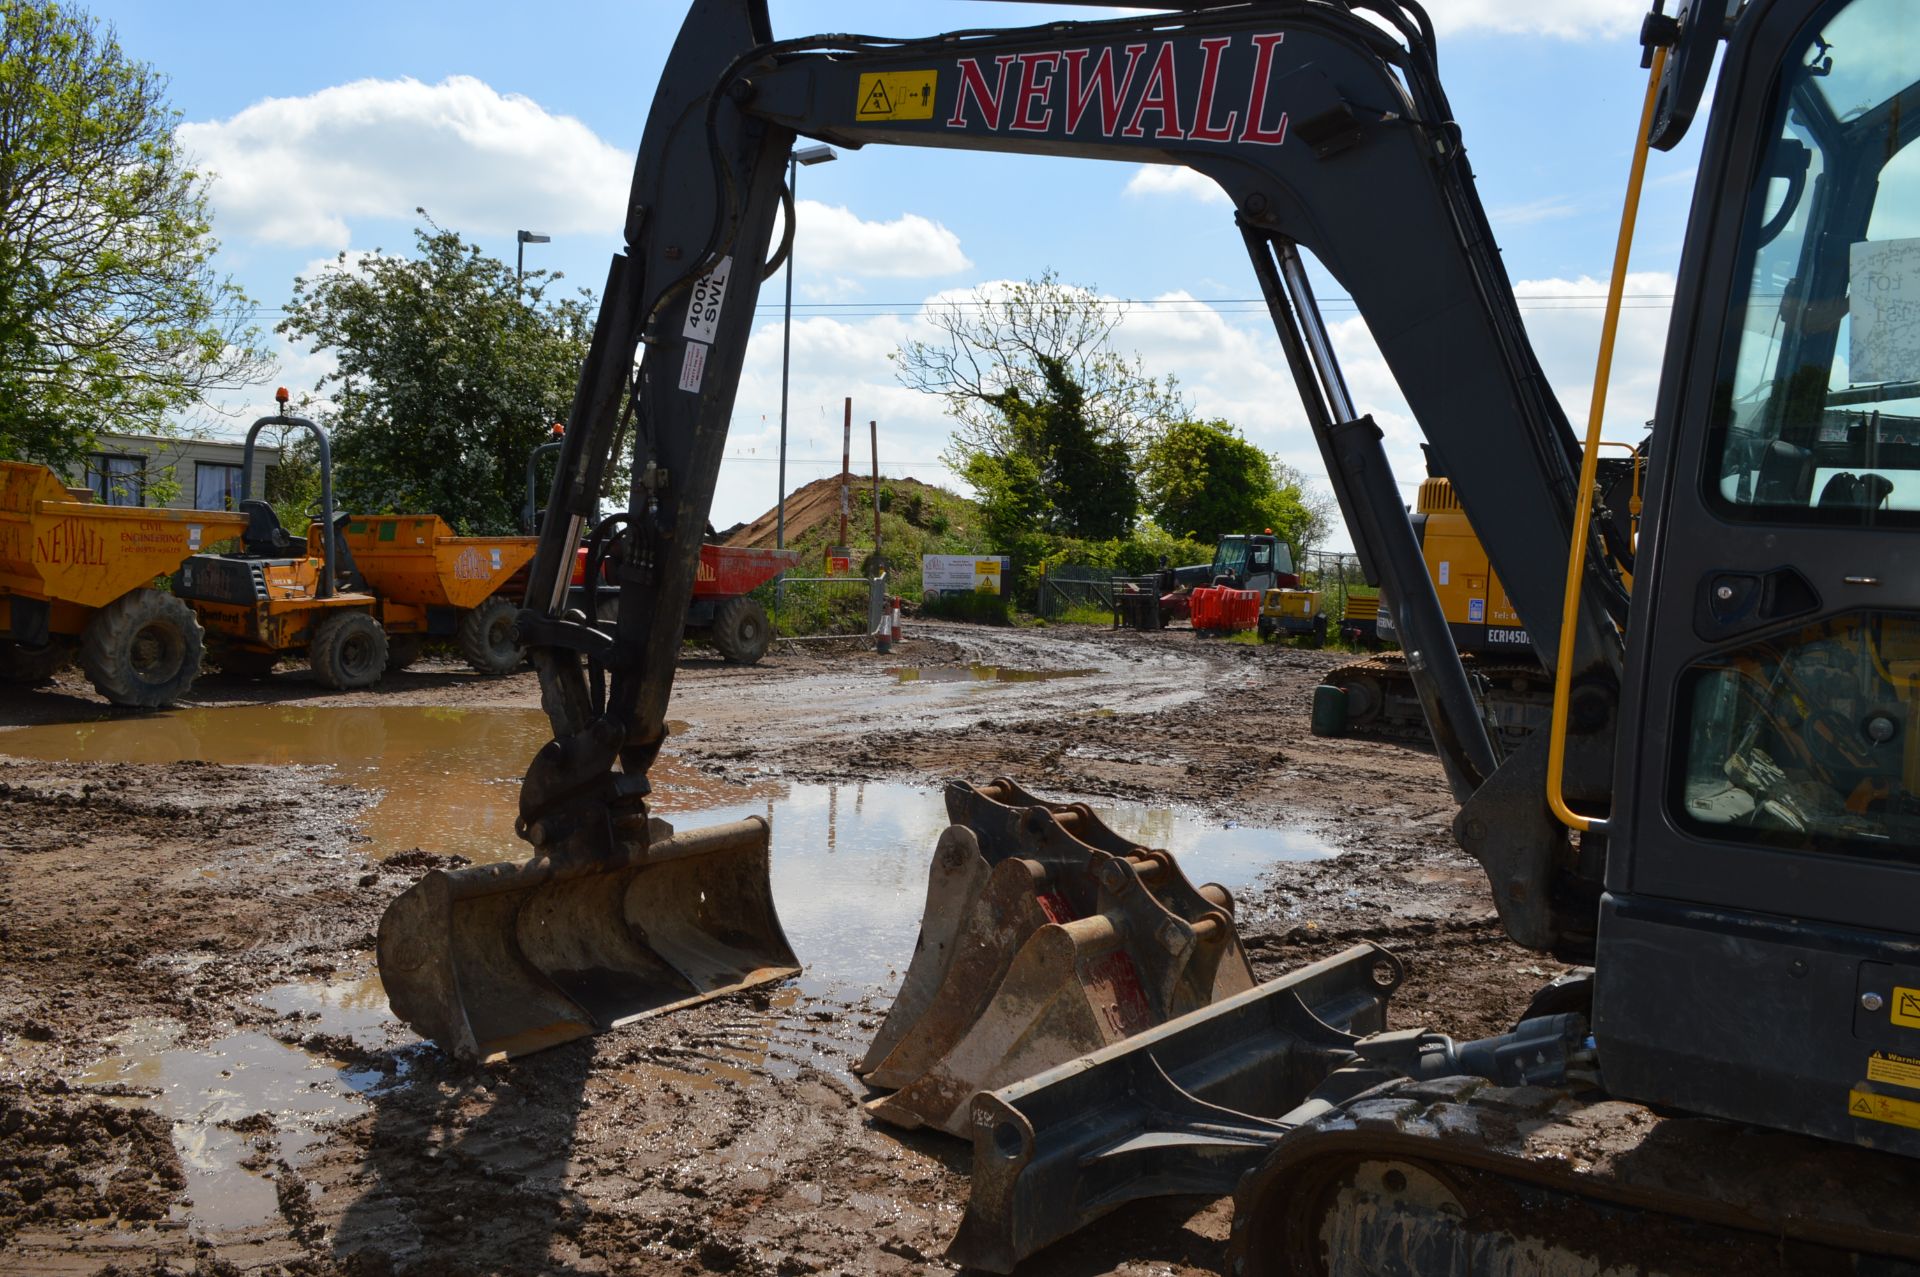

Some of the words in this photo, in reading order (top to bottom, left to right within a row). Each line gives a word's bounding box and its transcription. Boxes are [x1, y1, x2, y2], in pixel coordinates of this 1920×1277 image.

[946, 31, 1289, 145] NEWALL
[704, 275, 726, 323] SWL
[36, 517, 109, 566] NEWALL
[121, 532, 183, 544] ENGINEERING
[1888, 1052, 1920, 1065] Warnin
